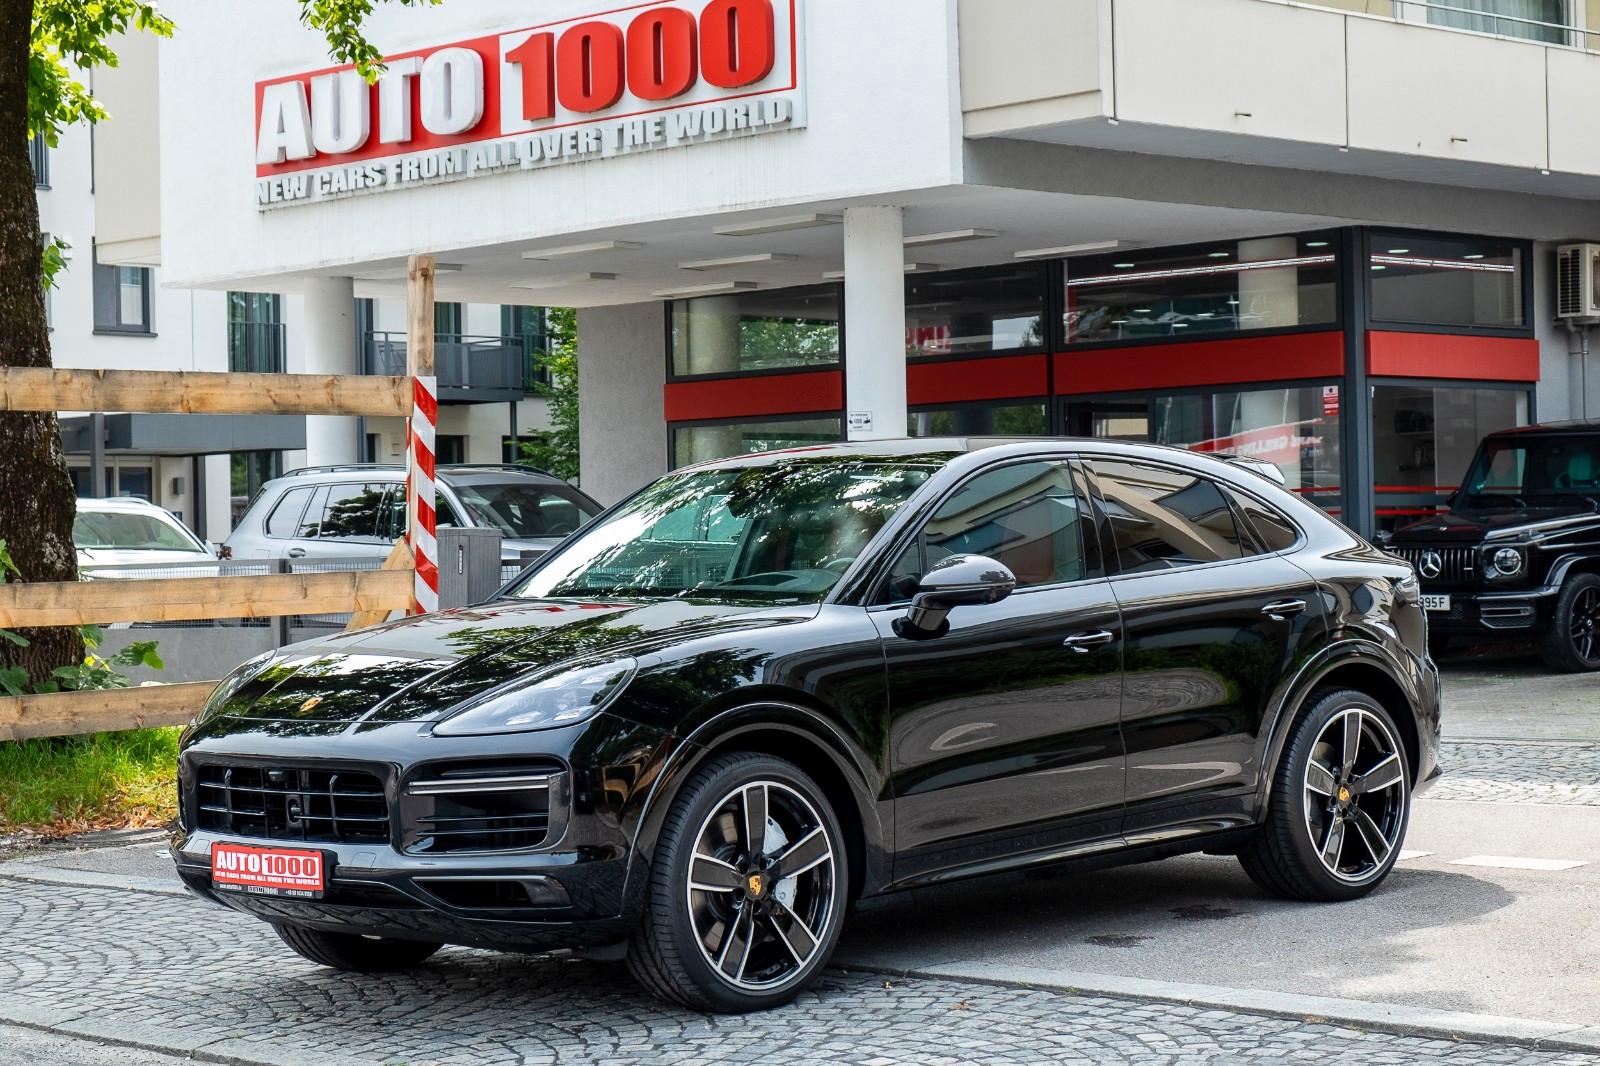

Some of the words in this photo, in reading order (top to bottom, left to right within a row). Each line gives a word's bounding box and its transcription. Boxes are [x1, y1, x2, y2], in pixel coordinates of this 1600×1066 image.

[256, 47, 485, 164] AUTO
[505, 0, 776, 121] 1000
[257, 175, 313, 205] NEW
[318, 164, 387, 195] CARS
[388, 149, 464, 184] FROM
[468, 139, 521, 172] ALL
[524, 128, 603, 163] OVER
[602, 115, 668, 151] THE
[669, 98, 793, 139] WORLD
[216, 851, 260, 872] AUTO
[265, 855, 317, 876] 1000
